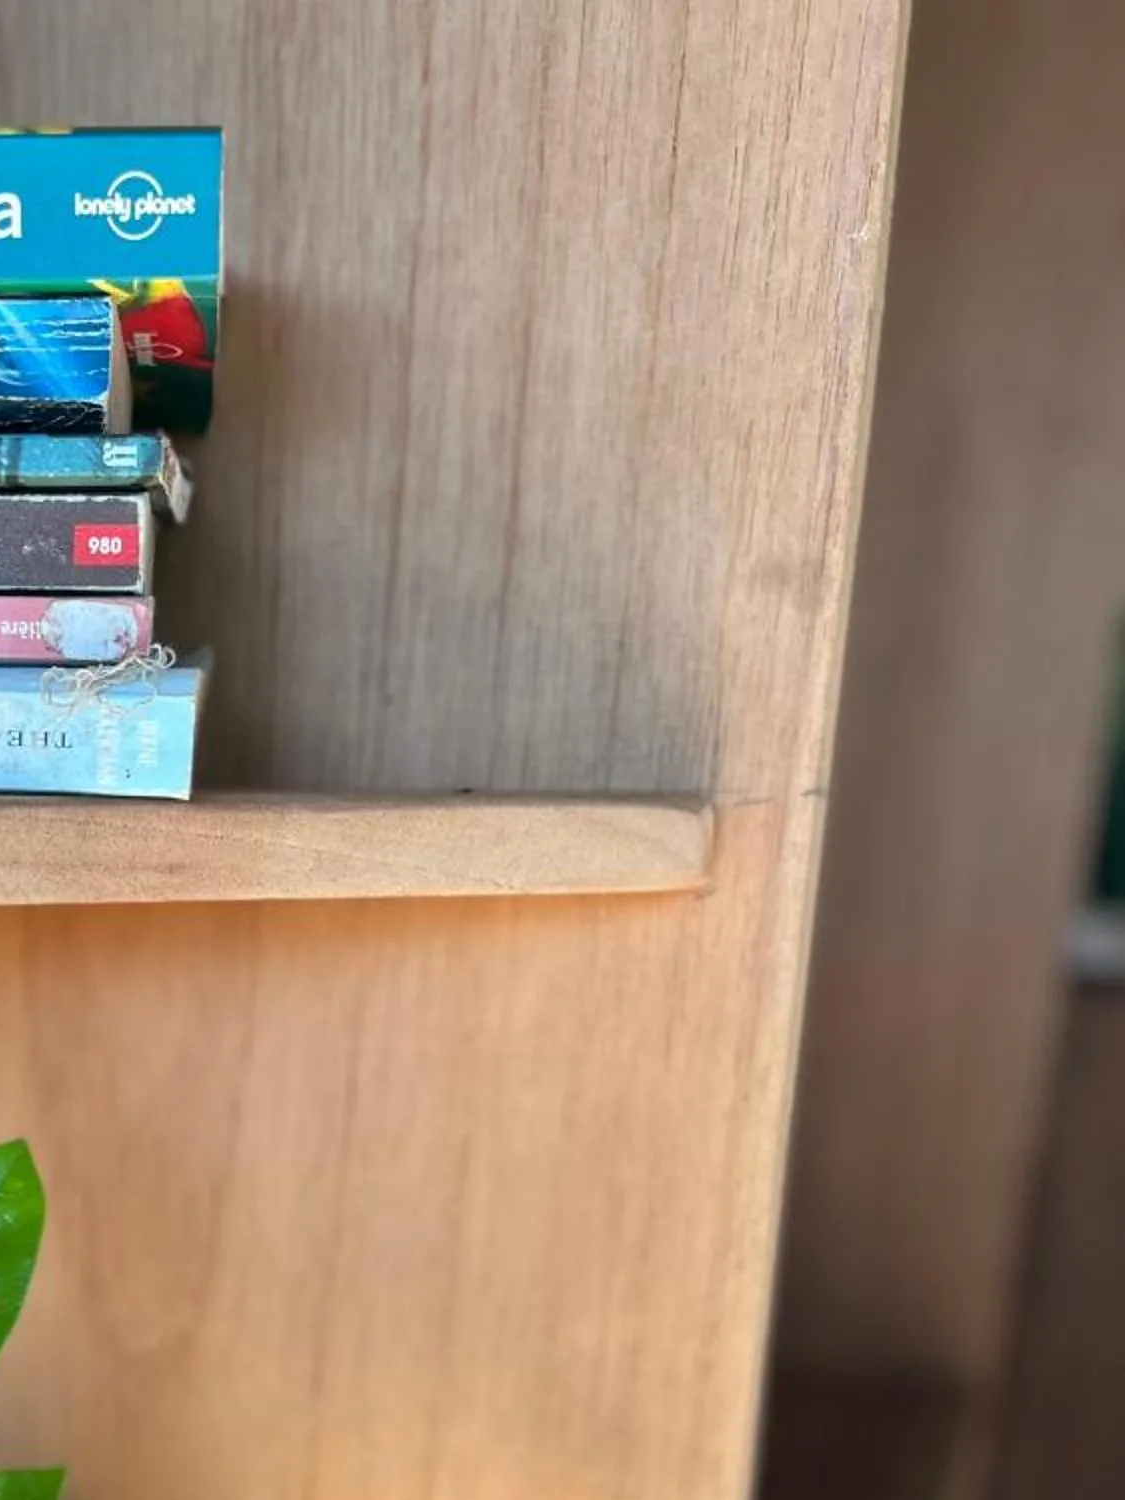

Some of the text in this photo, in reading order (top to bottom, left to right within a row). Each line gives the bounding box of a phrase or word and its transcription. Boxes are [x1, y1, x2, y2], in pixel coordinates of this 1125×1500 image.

[74, 191, 197, 223] lonely planet
[87, 535, 124, 555] 980
[0, 619, 47, 641] lière
[6, 728, 74, 750] THE
